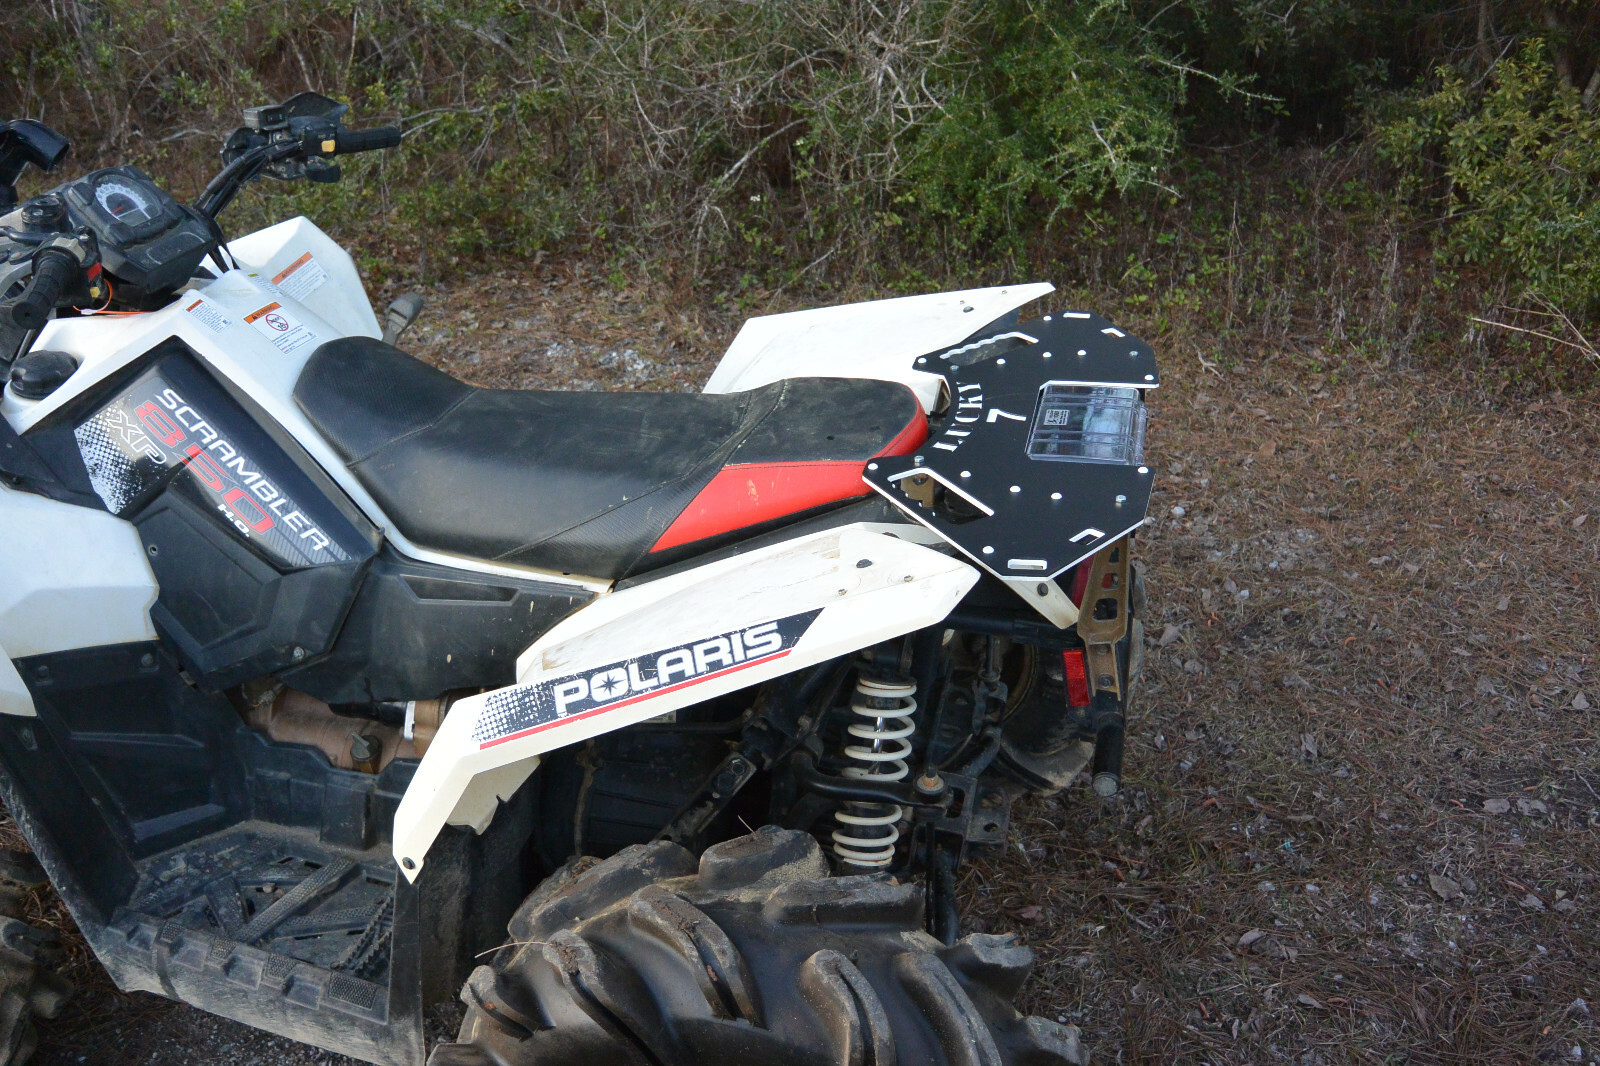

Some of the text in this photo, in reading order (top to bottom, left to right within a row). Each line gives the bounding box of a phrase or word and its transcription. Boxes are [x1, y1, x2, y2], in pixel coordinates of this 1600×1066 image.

[105, 409, 167, 465] XP
[932, 381, 983, 453] LUCKY
[985, 408, 1027, 423] 7
[134, 400, 275, 535] 850
[153, 388, 332, 552] SCRAMBLER
[217, 503, 250, 538] H.O.
[552, 621, 782, 717] POLARIS
